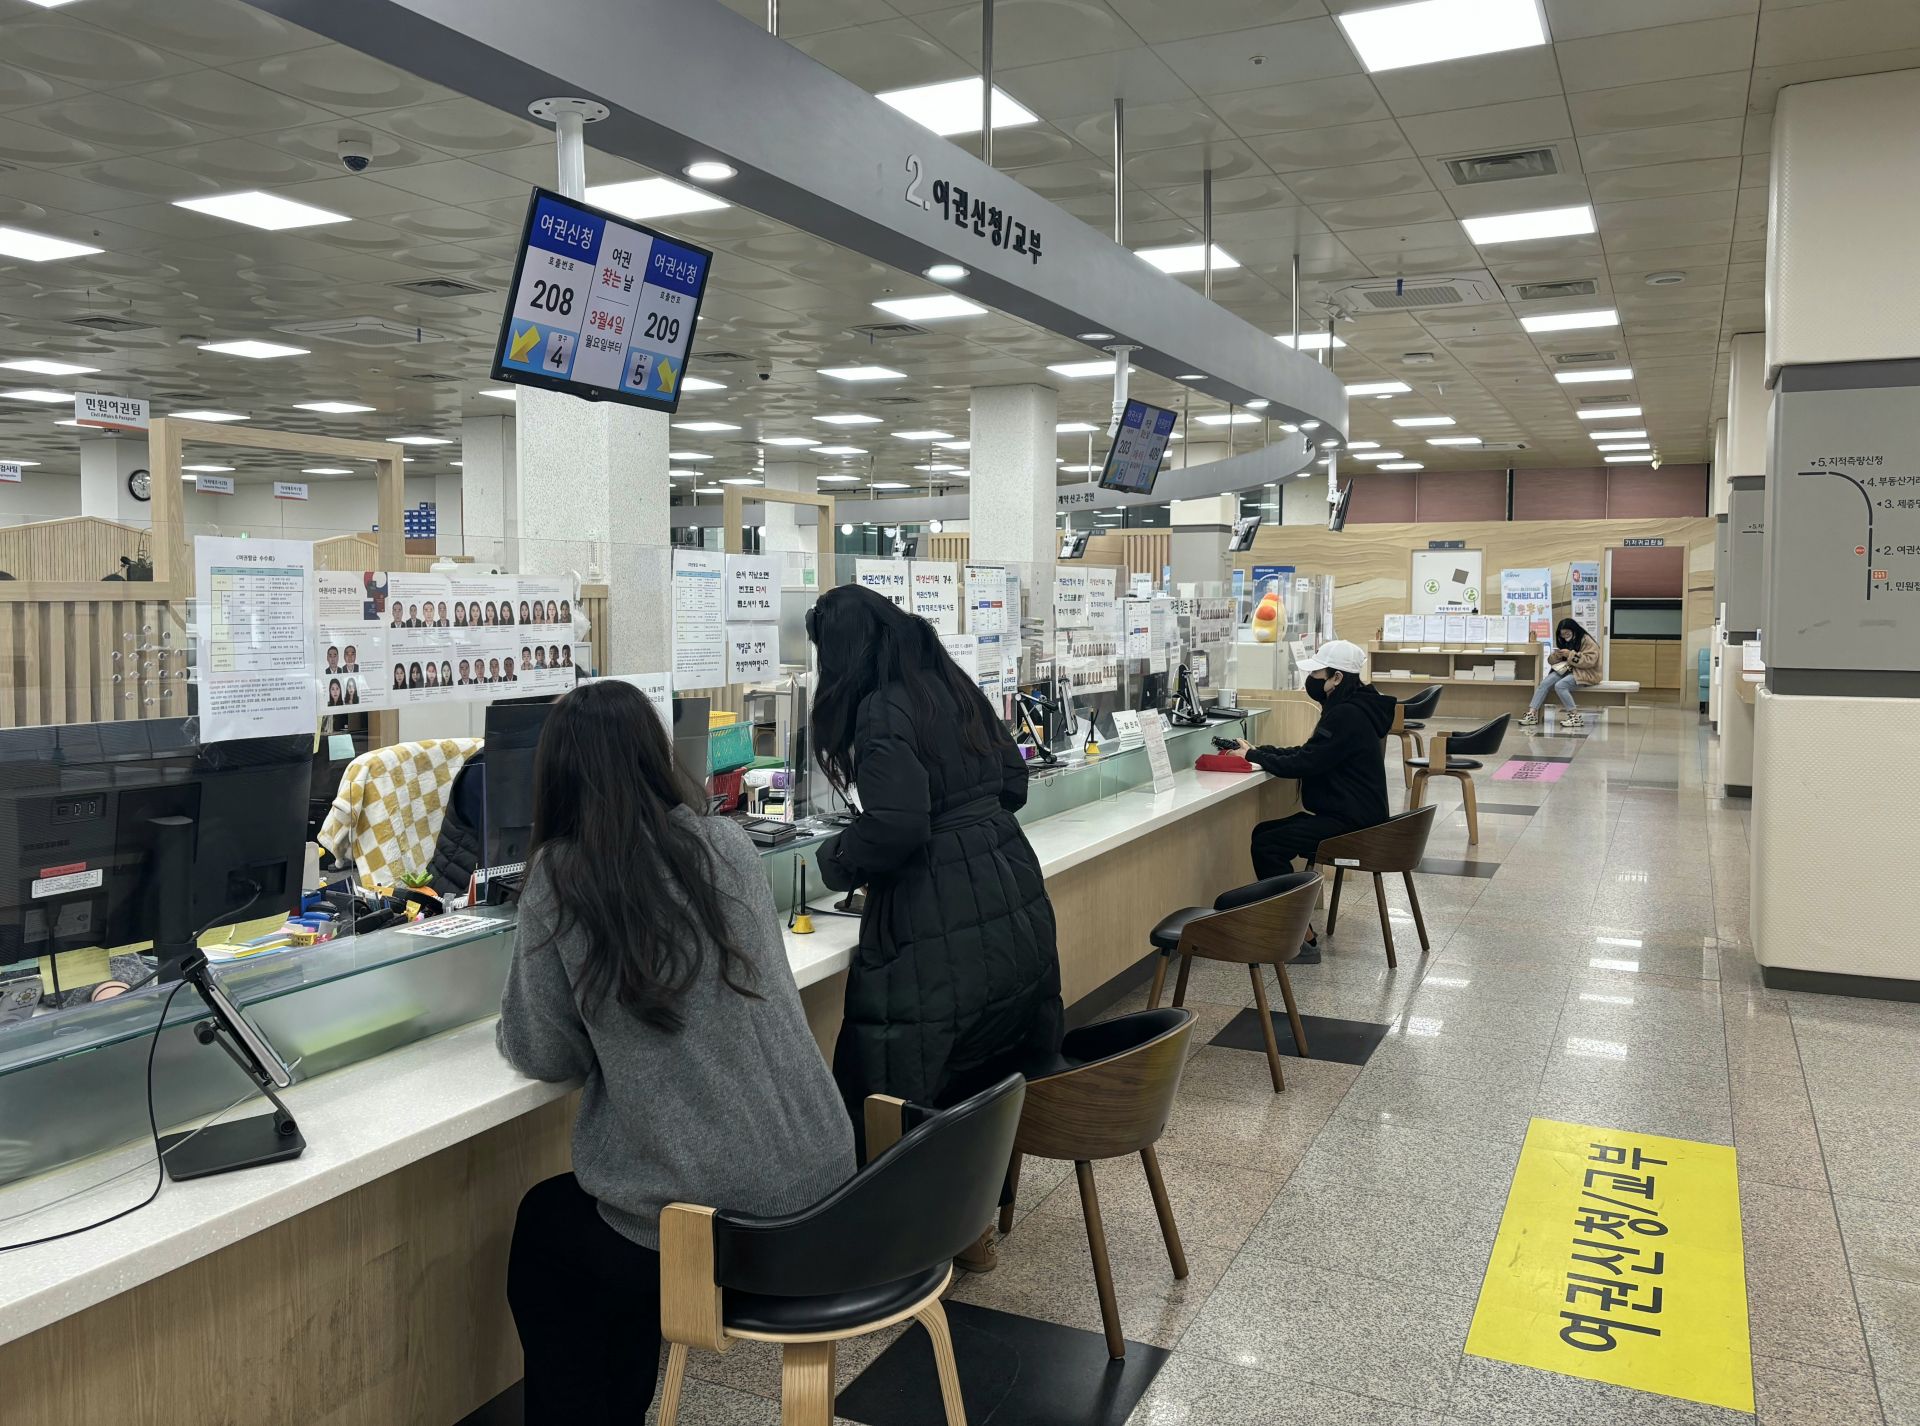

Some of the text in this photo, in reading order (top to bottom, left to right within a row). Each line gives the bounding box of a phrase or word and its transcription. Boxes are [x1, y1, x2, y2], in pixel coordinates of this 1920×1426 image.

[905, 153, 1042, 265] 2. 여권신청/교부
[540, 213, 594, 250] 여권신청
[612, 248, 632, 269] 여권
[654, 253, 698, 285] 여권신청
[601, 267, 634, 293] 찾는 날
[530, 279, 575, 316] 208
[589, 310, 625, 335] 3월4일
[644, 312, 680, 344] 209
[585, 334, 622, 355] 월요일부터
[550, 346, 563, 369] 4
[632, 365, 644, 386] 5
[86, 398, 141, 416] 민원여권팀
[1818, 457, 1828, 467] 5.
[1867, 477, 1877, 487] 4.
[1884, 499, 1894, 509] 3.
[1883, 545, 1894, 556] 2.
[1884, 582, 1893, 592] 1.
[1559, 1143, 1669, 1352] 여권신청/교부
